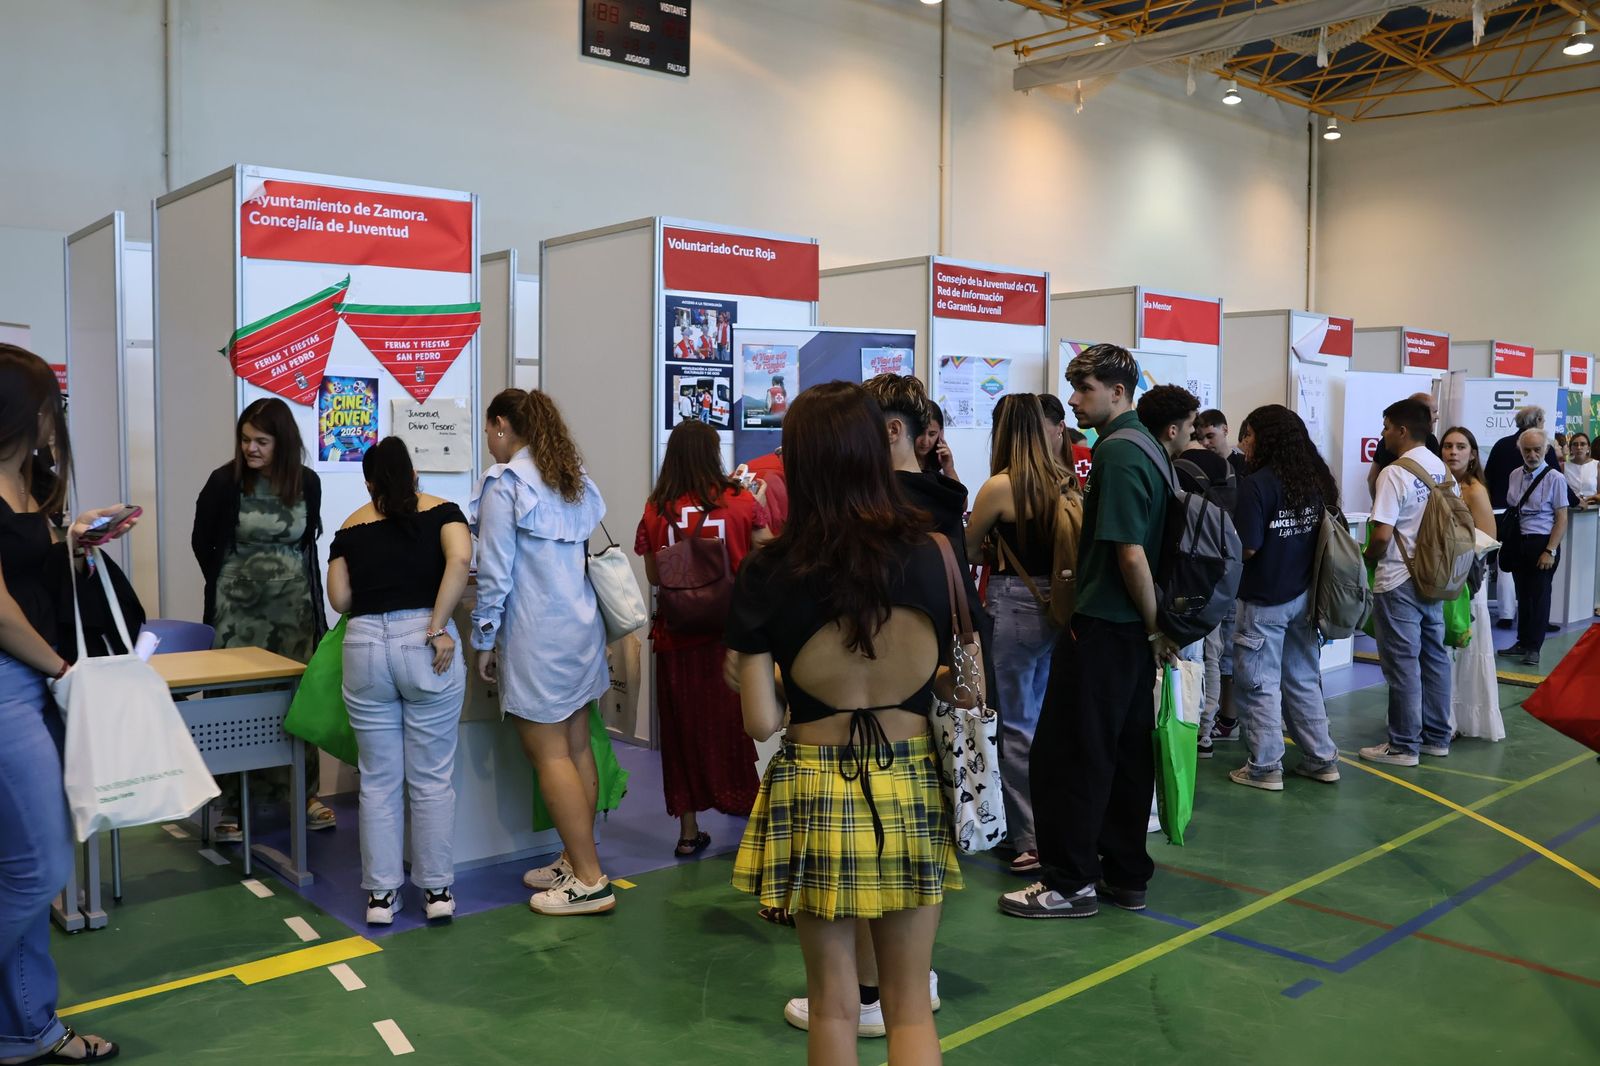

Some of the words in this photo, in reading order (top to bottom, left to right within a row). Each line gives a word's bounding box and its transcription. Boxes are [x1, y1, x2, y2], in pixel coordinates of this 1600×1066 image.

[660, 3, 687, 17] VISITANTE
[629, 21, 650, 32] PERIODO
[590, 45, 611, 57] FALTAS
[624, 54, 650, 65] JUGADOR
[667, 62, 686, 74] FALTAS
[354, 202, 371, 216] de
[373, 204, 428, 222] Zamora.
[249, 211, 324, 231] Concejalía
[326, 219, 344, 233] de
[347, 220, 409, 239] Juventud
[668, 237, 731, 255] Voluntariado
[732, 245, 754, 258] Cruz
[755, 247, 776, 261] Roja
[937, 272, 967, 286] Consejo
[968, 276, 976, 286] de
[976, 278, 983, 288] la
[983, 279, 1016, 291] Juventud
[1016, 282, 1024, 291] de
[1025, 283, 1038, 293] CYL.
[937, 286, 951, 297] Red
[952, 287, 961, 298] de
[962, 289, 1004, 302] Información
[937, 299, 946, 309] de
[948, 300, 977, 313] Garantía
[977, 305, 1002, 315] Juvenil
[254, 352, 282, 370] FERIAS
[283, 348, 289, 356] Y
[290, 334, 320, 354] FIESTAS
[385, 341, 411, 349] FERIAS
[413, 341, 418, 349] Y
[421, 340, 450, 349] FIESTAS
[271, 363, 288, 377] SAN
[289, 350, 315, 369] PEDRO
[396, 353, 412, 361] SAN
[415, 352, 441, 360] PEDRO
[333, 395, 364, 411] CINE
[326, 410, 370, 427] JOVEN
[408, 421, 429, 431] Divino
[340, 427, 362, 436] 2025
